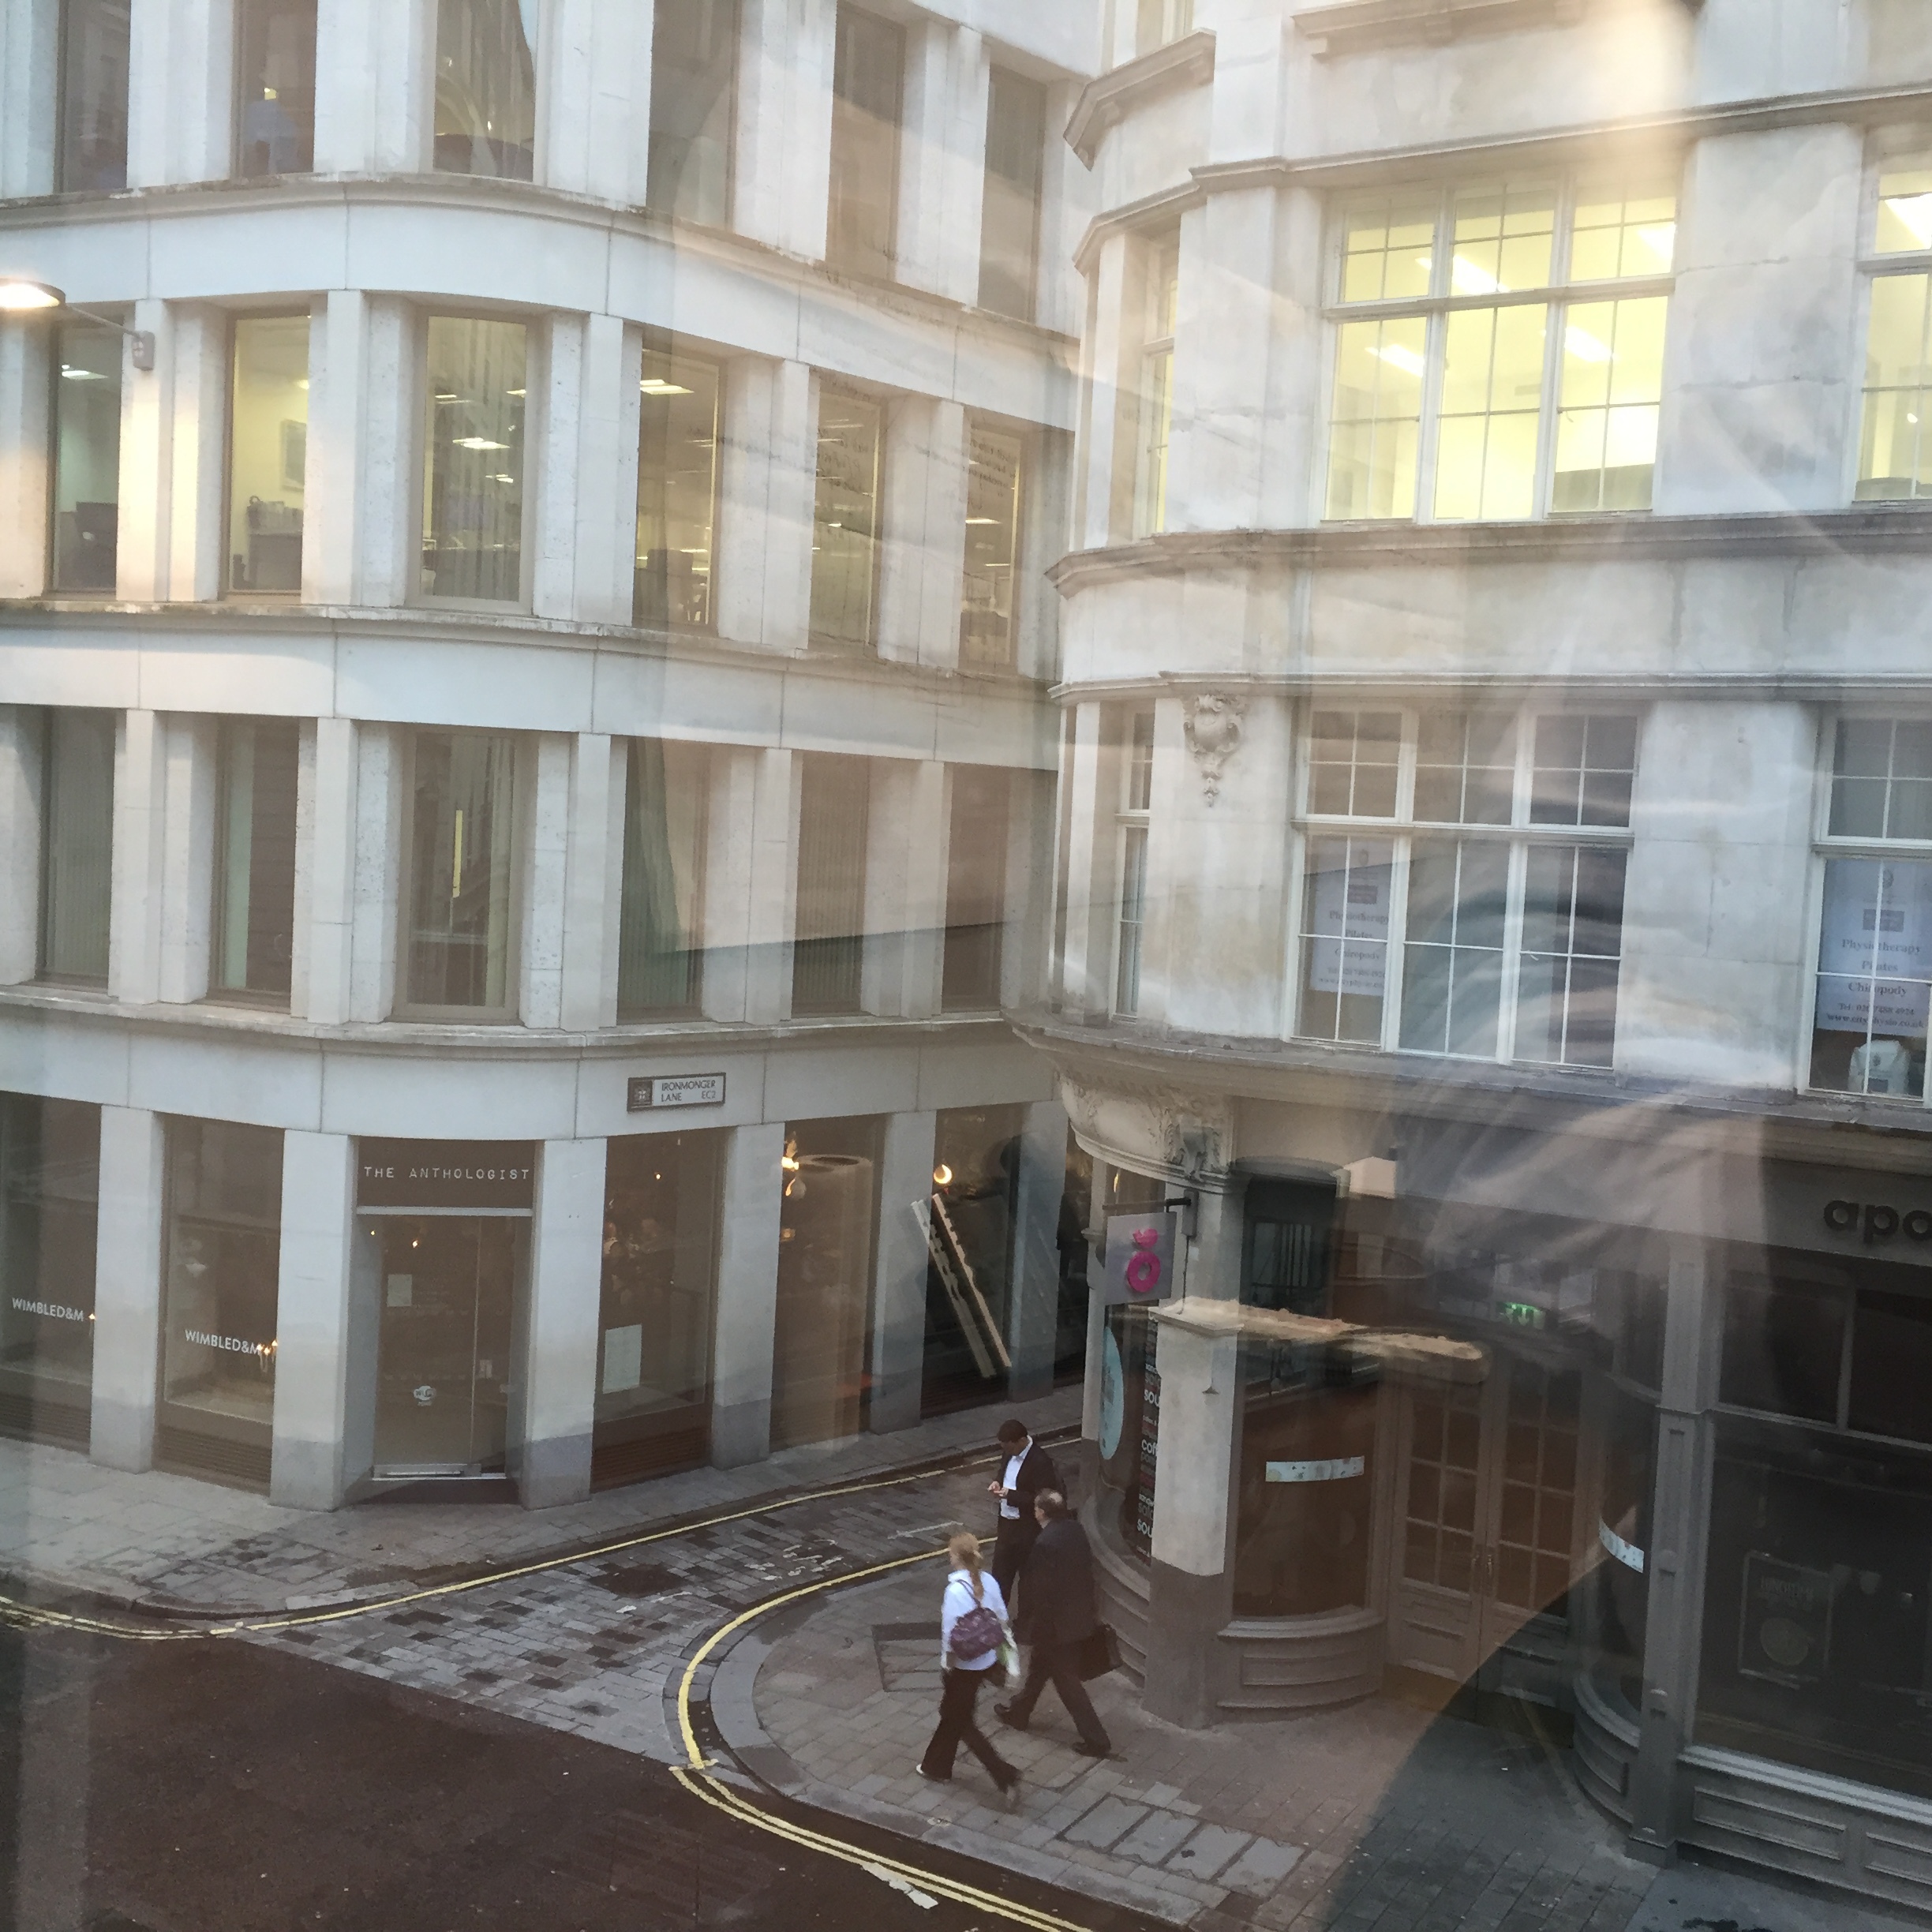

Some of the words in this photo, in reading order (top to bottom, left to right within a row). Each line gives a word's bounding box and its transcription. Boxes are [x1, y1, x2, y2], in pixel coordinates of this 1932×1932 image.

[1842, 938, 1920, 955] Physitherapy
[1862, 960, 1899, 972] Piates
[1848, 981, 1908, 998] Chiopody
[661, 1080, 716, 1091] IRONMONGER
[661, 1093, 682, 1102] LANE
[701, 1091, 716, 1099] EC2
[364, 1166, 395, 1178] THE
[409, 1167, 530, 1180] ANTHOLOGIST
